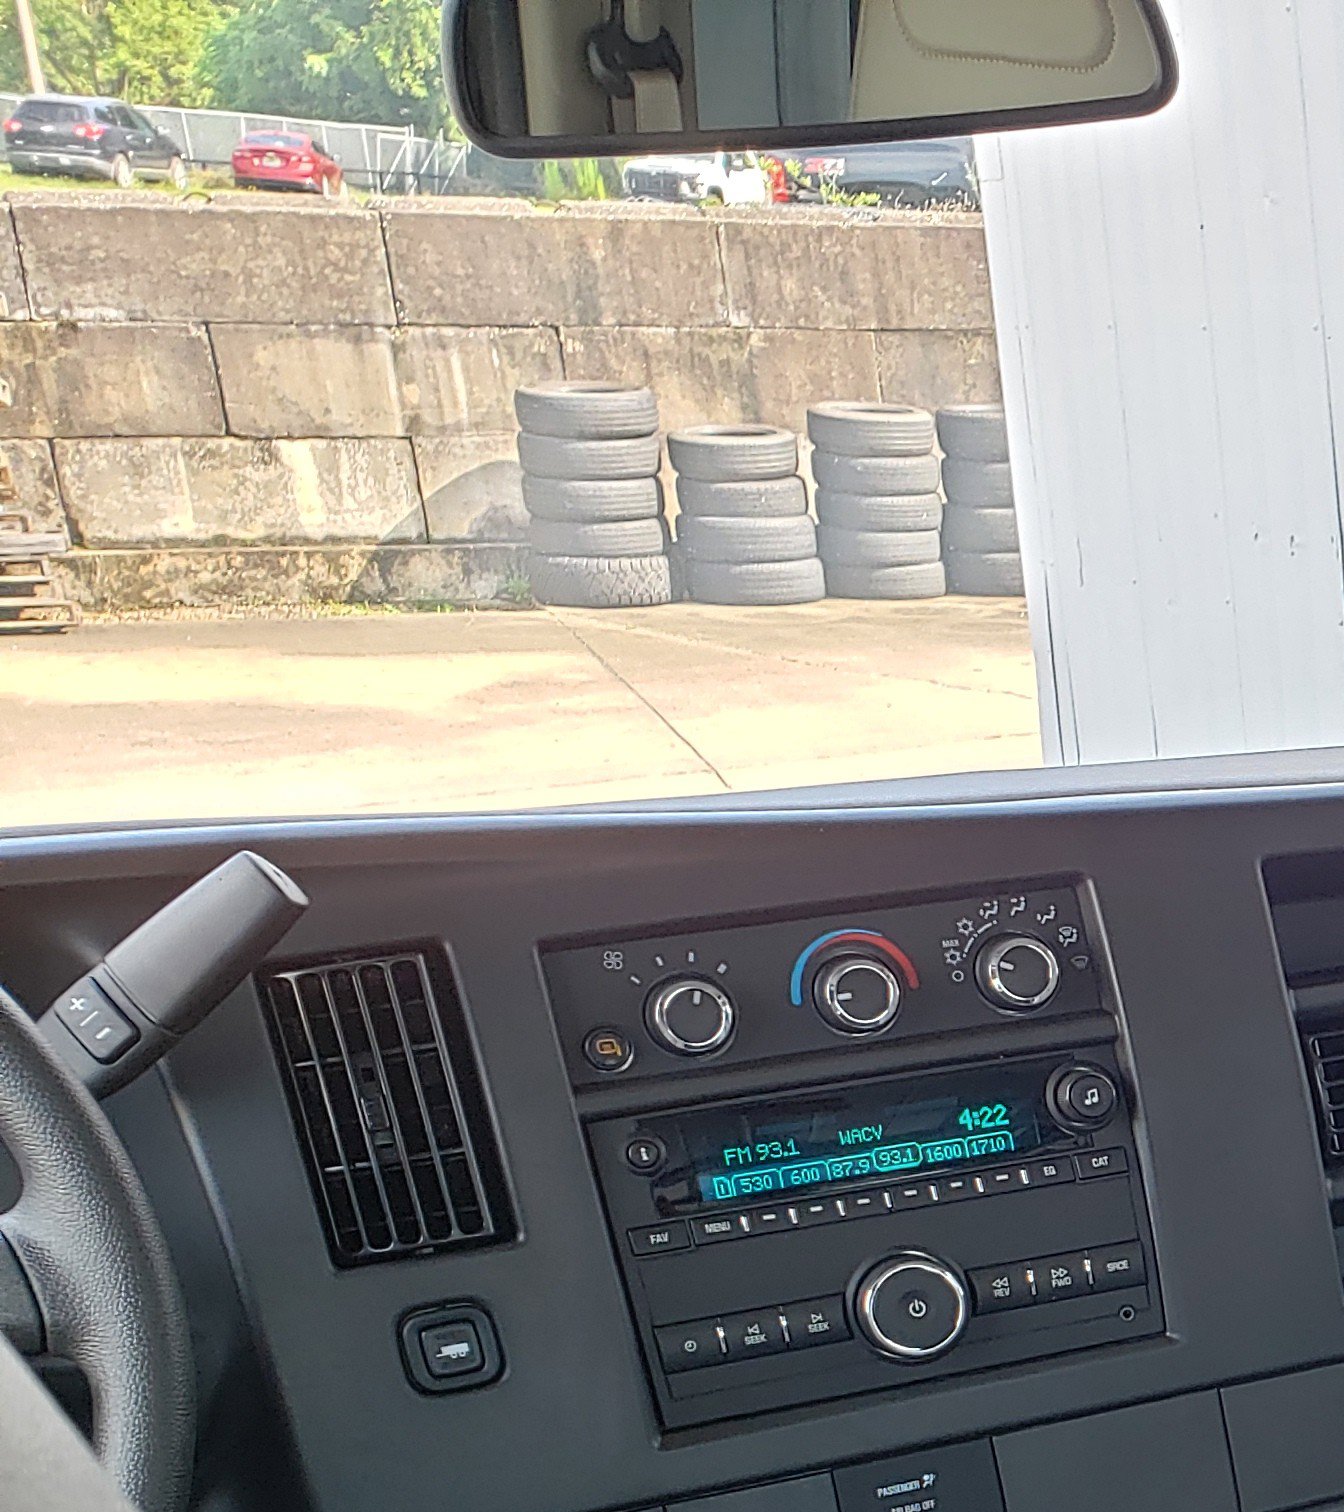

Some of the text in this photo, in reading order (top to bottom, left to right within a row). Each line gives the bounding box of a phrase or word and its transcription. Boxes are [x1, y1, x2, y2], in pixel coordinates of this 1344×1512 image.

[959, 1104, 1010, 1131] 4:22
[838, 1124, 883, 1146] WACV
[723, 1138, 800, 1166] FM 93.1
[740, 1174, 773, 1193] 530
[790, 1166, 821, 1185] 600
[832, 1158, 870, 1178] 87.9
[878, 1150, 916, 1166] 93.1
[926, 1143, 963, 1163] 1600
[970, 1137, 1006, 1156] 1710
[1092, 1156, 1110, 1168] CAT
[704, 1220, 731, 1235] MENU
[650, 1232, 670, 1246] FAV
[1052, 1276, 1072, 1288] FWD
[994, 1286, 1010, 1297] REV
[808, 1320, 830, 1334] SEEK
[744, 1333, 768, 1347] SEEK
